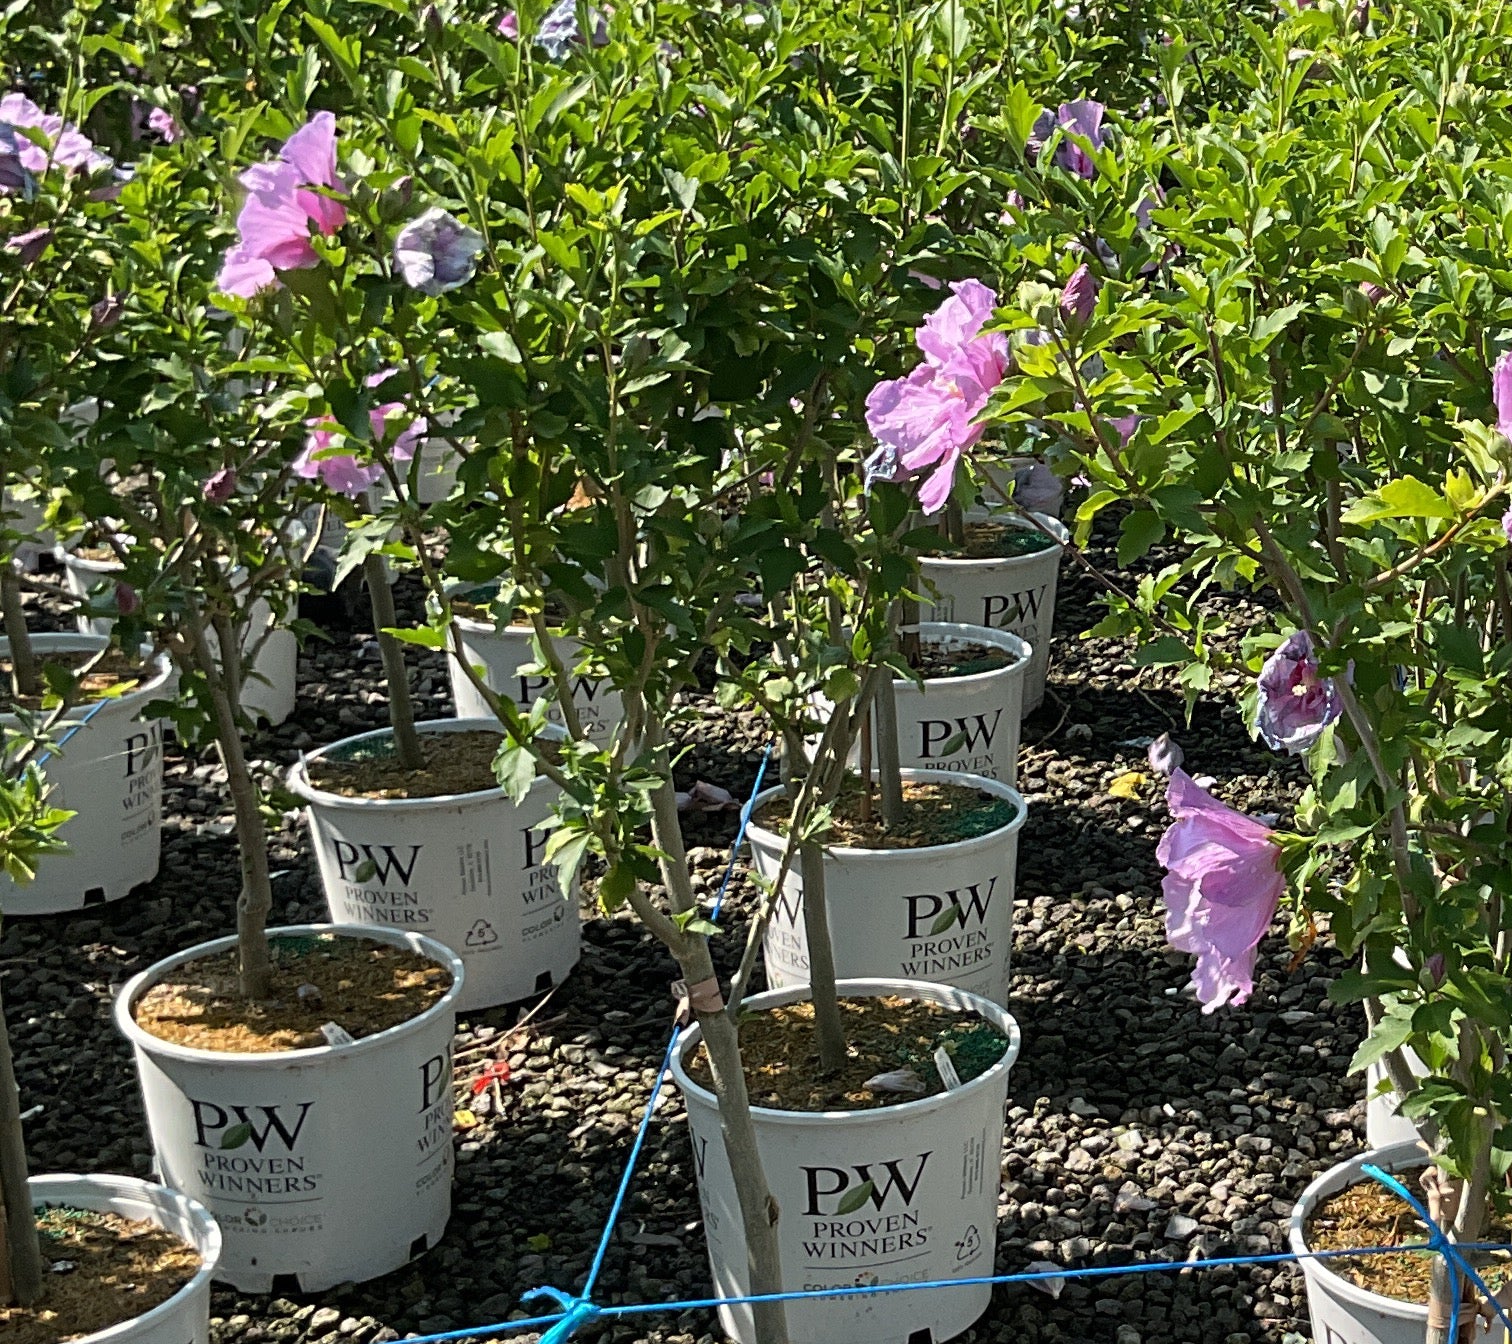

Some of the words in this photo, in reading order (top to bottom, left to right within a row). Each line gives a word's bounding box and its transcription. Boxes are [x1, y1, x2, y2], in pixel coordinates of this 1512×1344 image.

[981, 584, 1047, 627] PW
[917, 708, 1003, 759] PW
[332, 839, 424, 887] PW
[345, 887, 418, 905] PROVEN
[902, 877, 998, 940] PW
[344, 903, 430, 923] WINNERS
[911, 928, 988, 958] PROVEN
[901, 945, 992, 977] WINNERS
[191, 1099, 316, 1153] PW
[204, 1154, 304, 1174] PROVEN
[198, 1170, 317, 1194] WINNERS
[799, 1150, 934, 1216] PW
[813, 1210, 919, 1238] PROVEN
[802, 1228, 929, 1259] WINNERS
